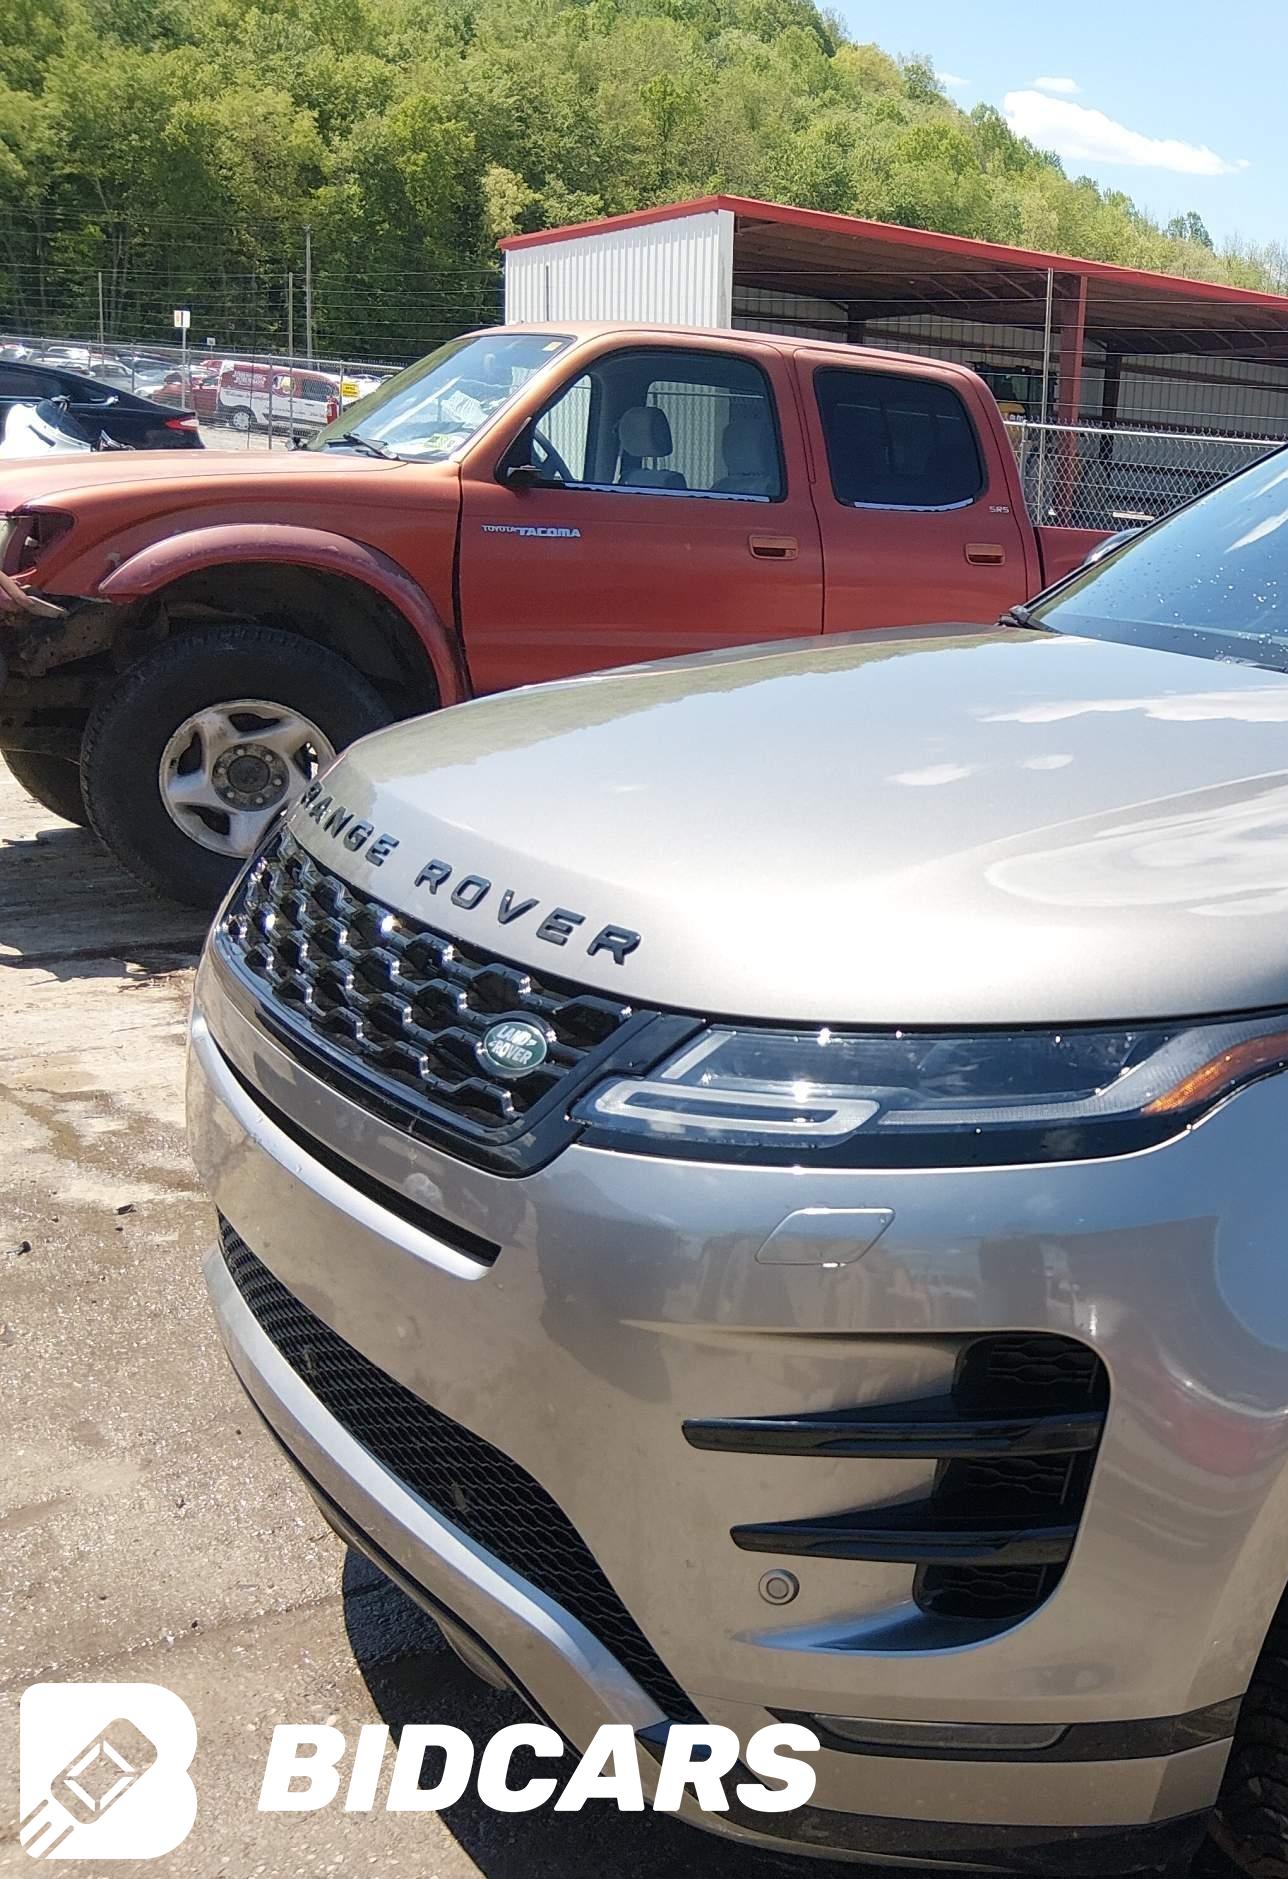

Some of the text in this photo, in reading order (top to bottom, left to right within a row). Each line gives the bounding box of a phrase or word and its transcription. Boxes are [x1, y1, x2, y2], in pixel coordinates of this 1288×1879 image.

[988, 505, 1010, 514] SR5
[481, 525, 581, 538] TOYOTA TACOMA
[301, 779, 642, 966] RANGE ROVER
[496, 1025, 533, 1046] LAND
[491, 1040, 534, 1065] ROVER
